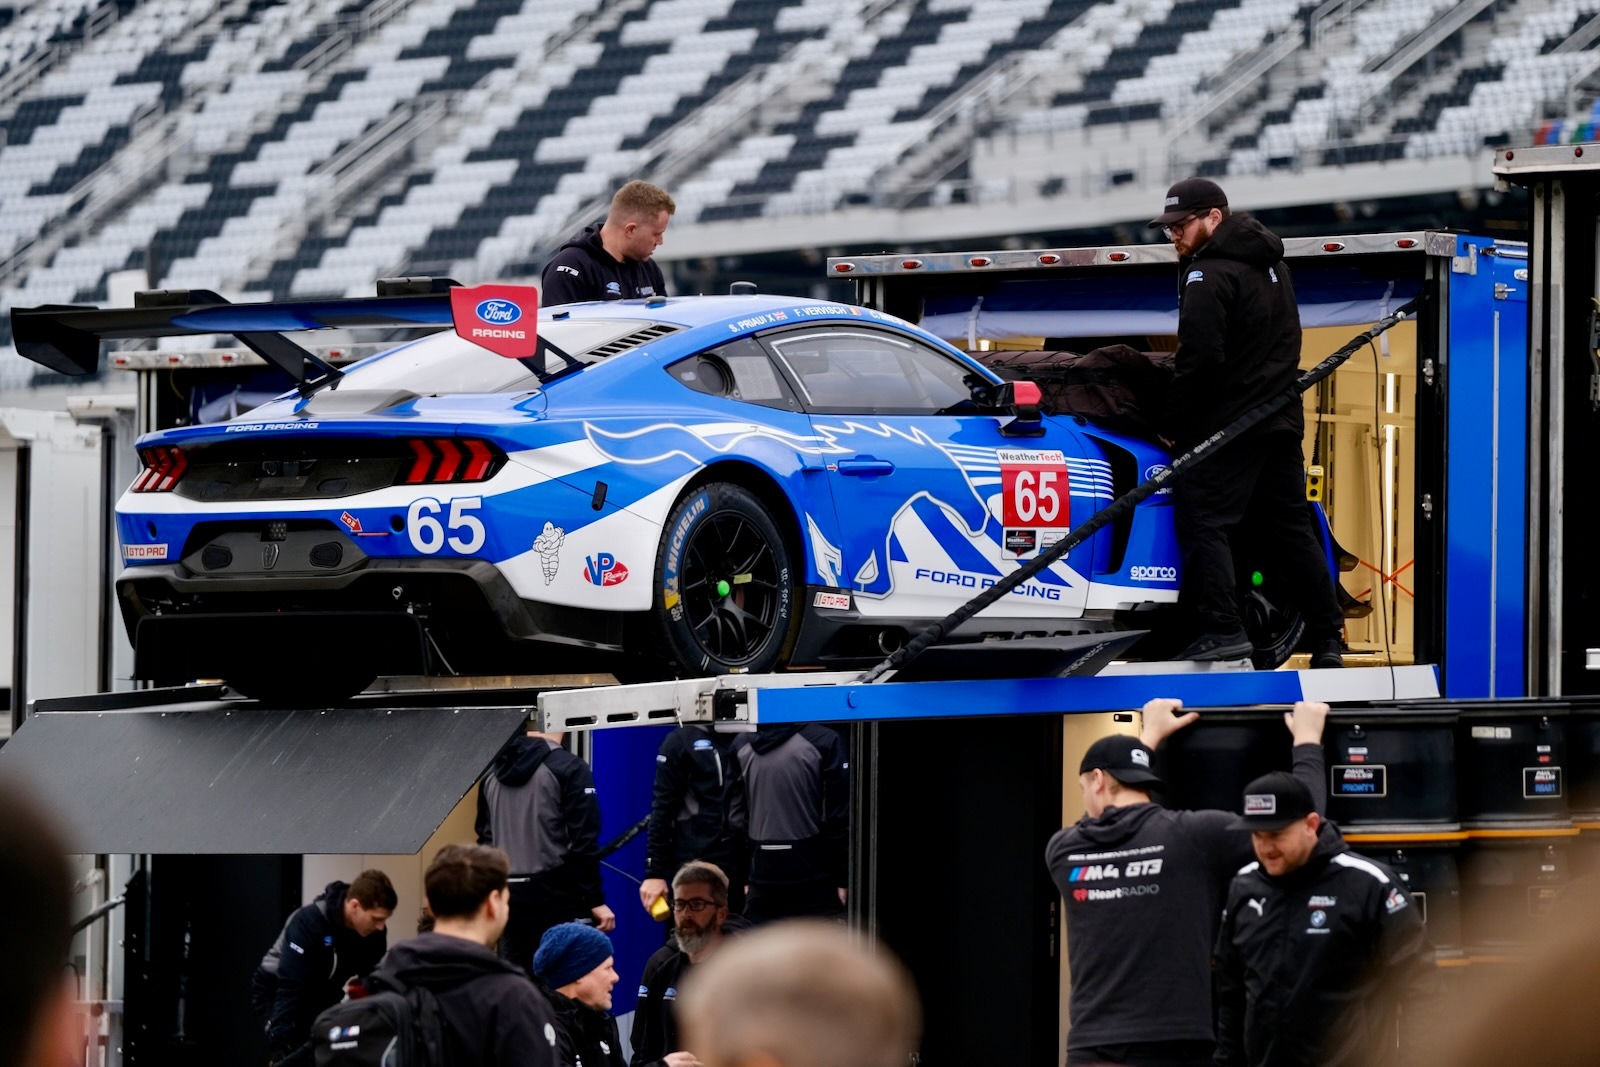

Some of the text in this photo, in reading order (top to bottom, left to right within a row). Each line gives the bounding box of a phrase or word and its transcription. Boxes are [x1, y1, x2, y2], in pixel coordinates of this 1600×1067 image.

[484, 302, 514, 321] Ford
[793, 306, 848, 317] F. VERVISCH
[472, 328, 526, 339] RACING
[225, 423, 319, 433] FORD RACING
[1000, 452, 1063, 461] WeatherTech
[1014, 471, 1060, 522] 65
[407, 497, 486, 555] 65
[667, 498, 705, 573] MICHELIN
[129, 547, 166, 557] GTD PRO
[585, 552, 615, 586] VP
[603, 570, 629, 584] Racing
[1130, 566, 1176, 581] sparco
[915, 568, 1061, 601] FORD RCING
[821, 595, 848, 607] GTD PRO
[1125, 858, 1163, 877] GT3
[1088, 883, 1160, 900] iHeartRADIO
